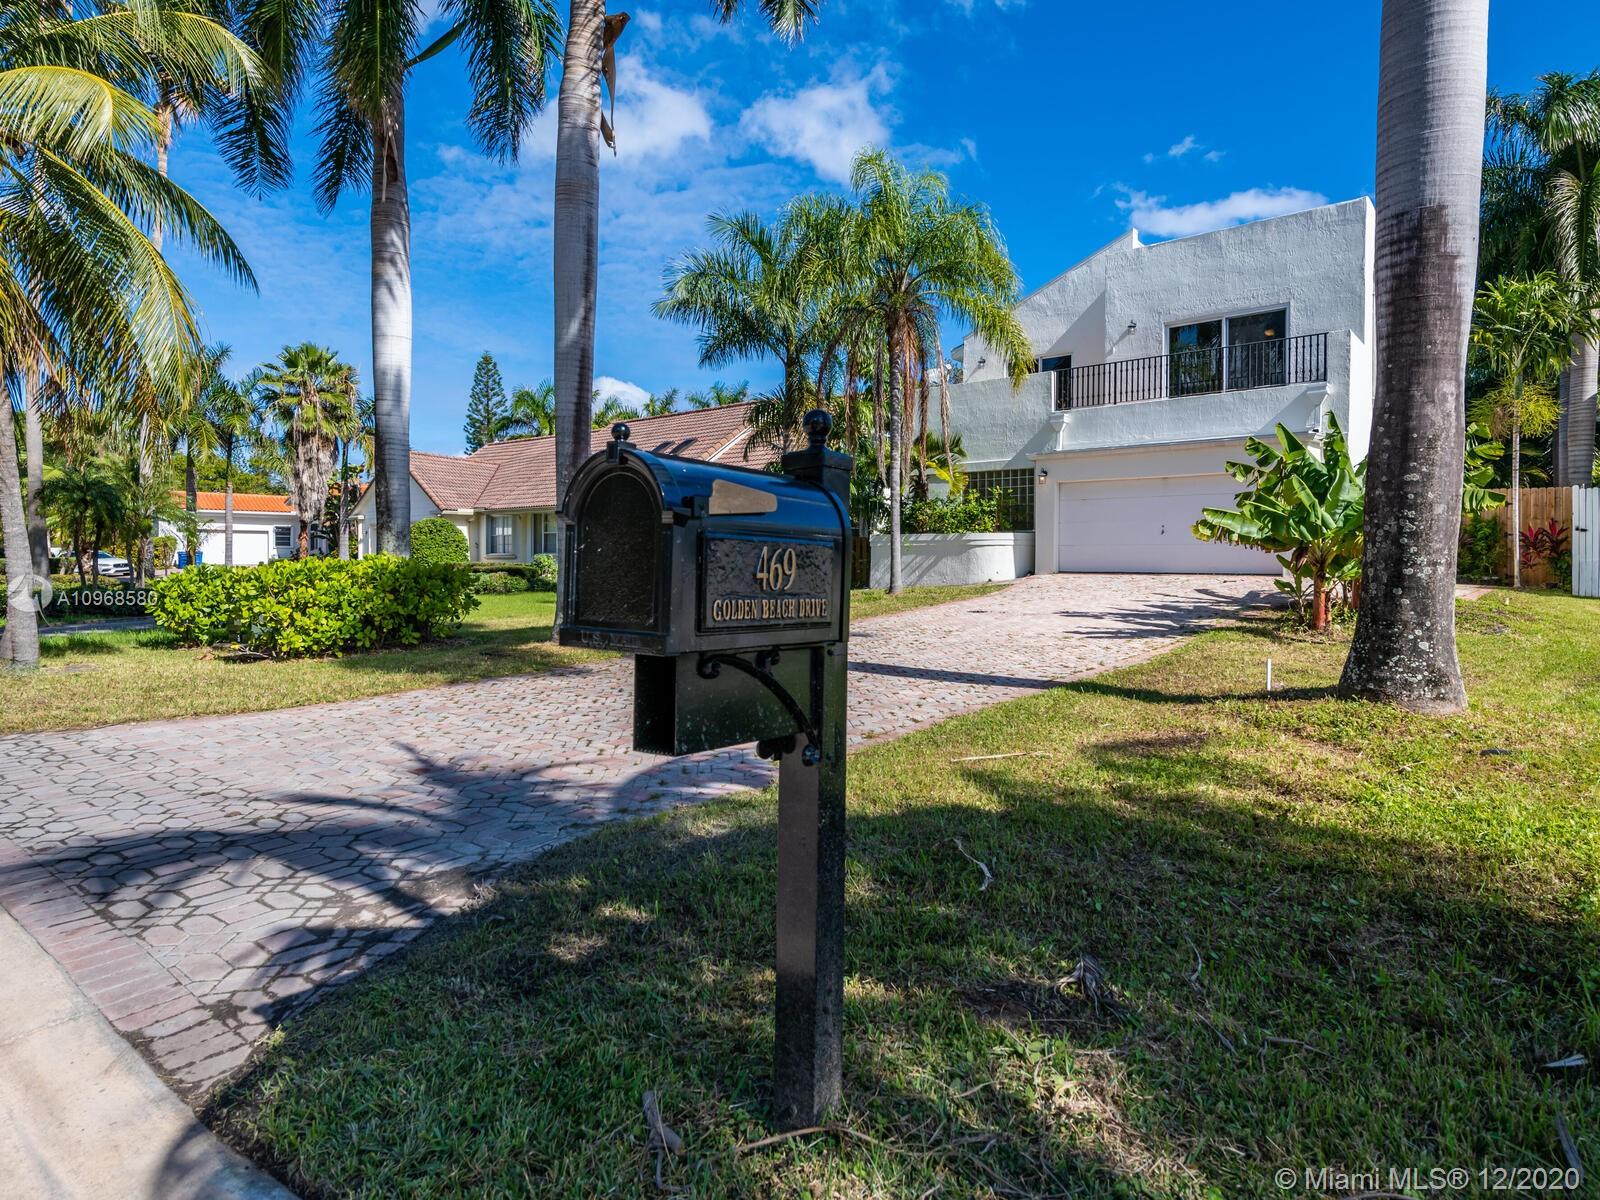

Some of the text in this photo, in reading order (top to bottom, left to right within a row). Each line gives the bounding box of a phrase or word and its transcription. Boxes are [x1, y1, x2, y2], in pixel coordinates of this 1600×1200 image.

[756, 546, 797, 591] 469
[713, 598, 828, 621] GOLDEN BEACH DRIVE
